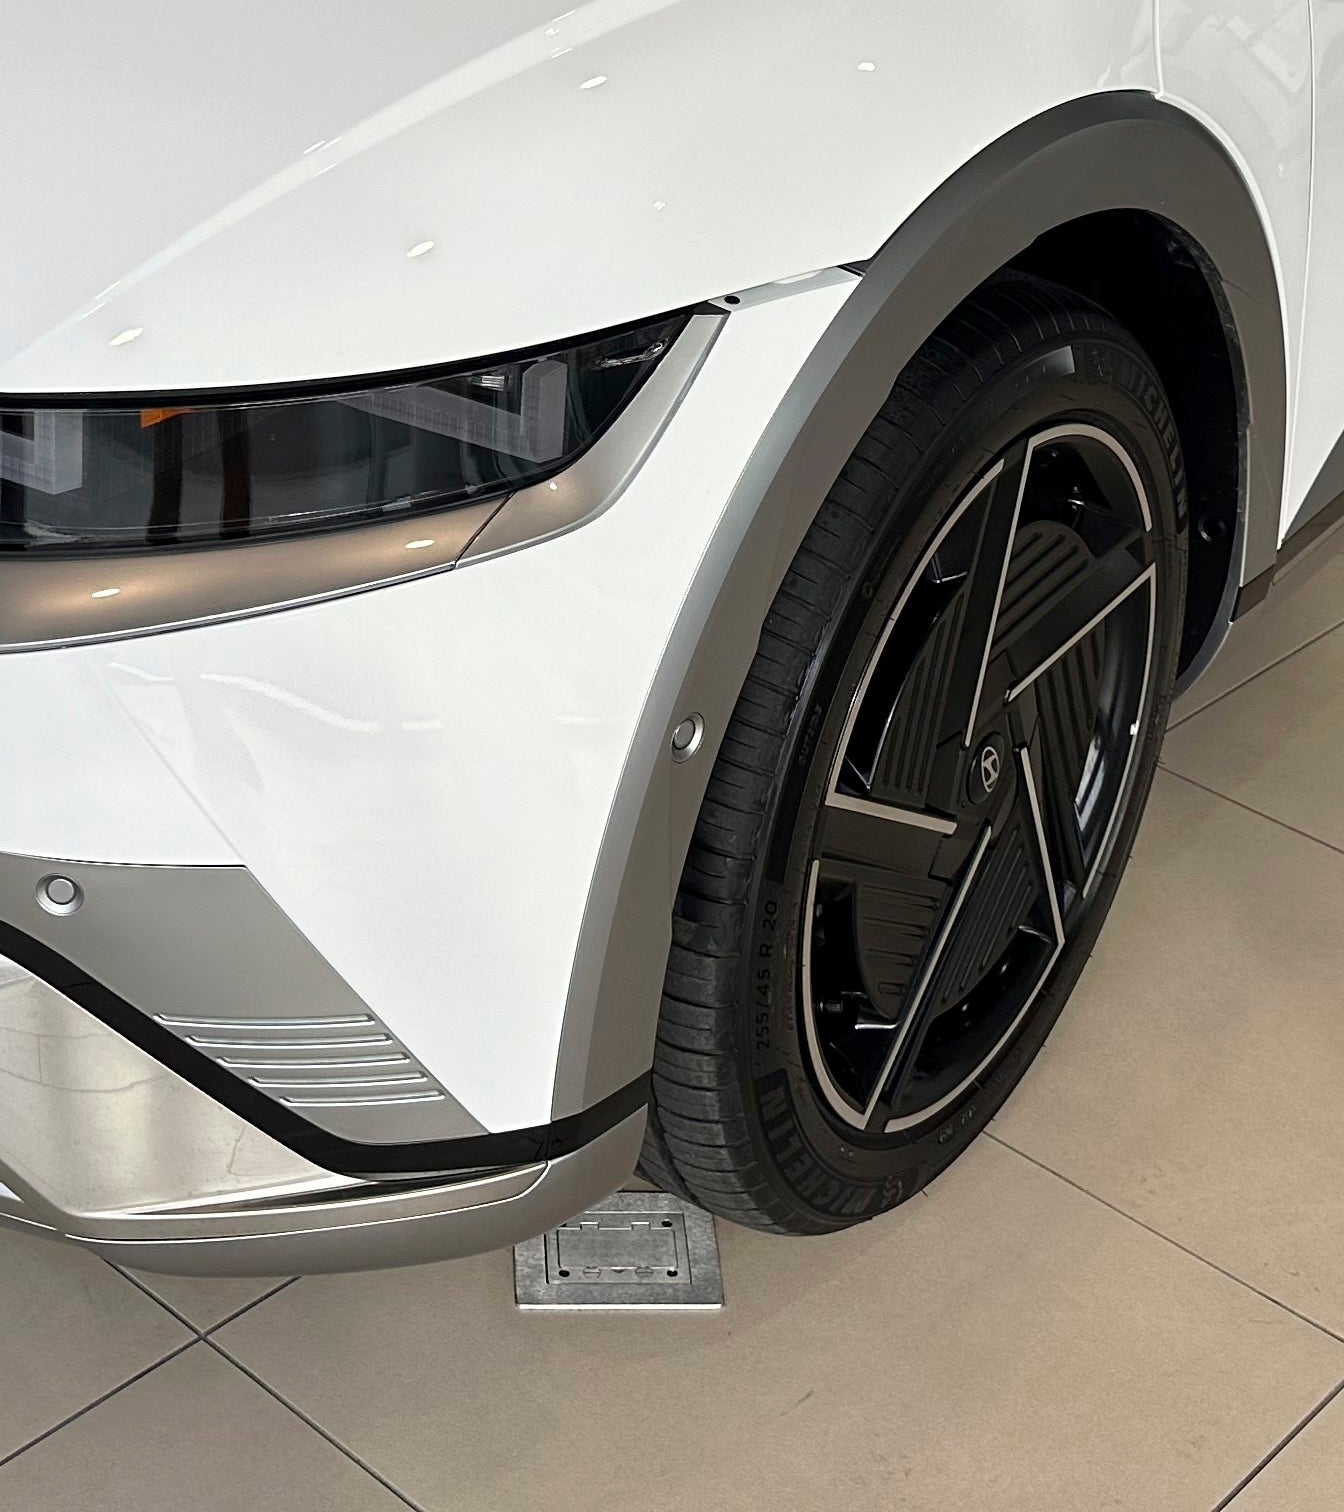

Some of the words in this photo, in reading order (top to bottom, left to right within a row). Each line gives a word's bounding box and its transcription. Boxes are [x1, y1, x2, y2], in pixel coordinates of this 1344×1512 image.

[763, 901, 777, 932] 20
[760, 944, 773, 957] R
[756, 968, 770, 1050] 255/45
[760, 1085, 877, 1215] MICHELIN
